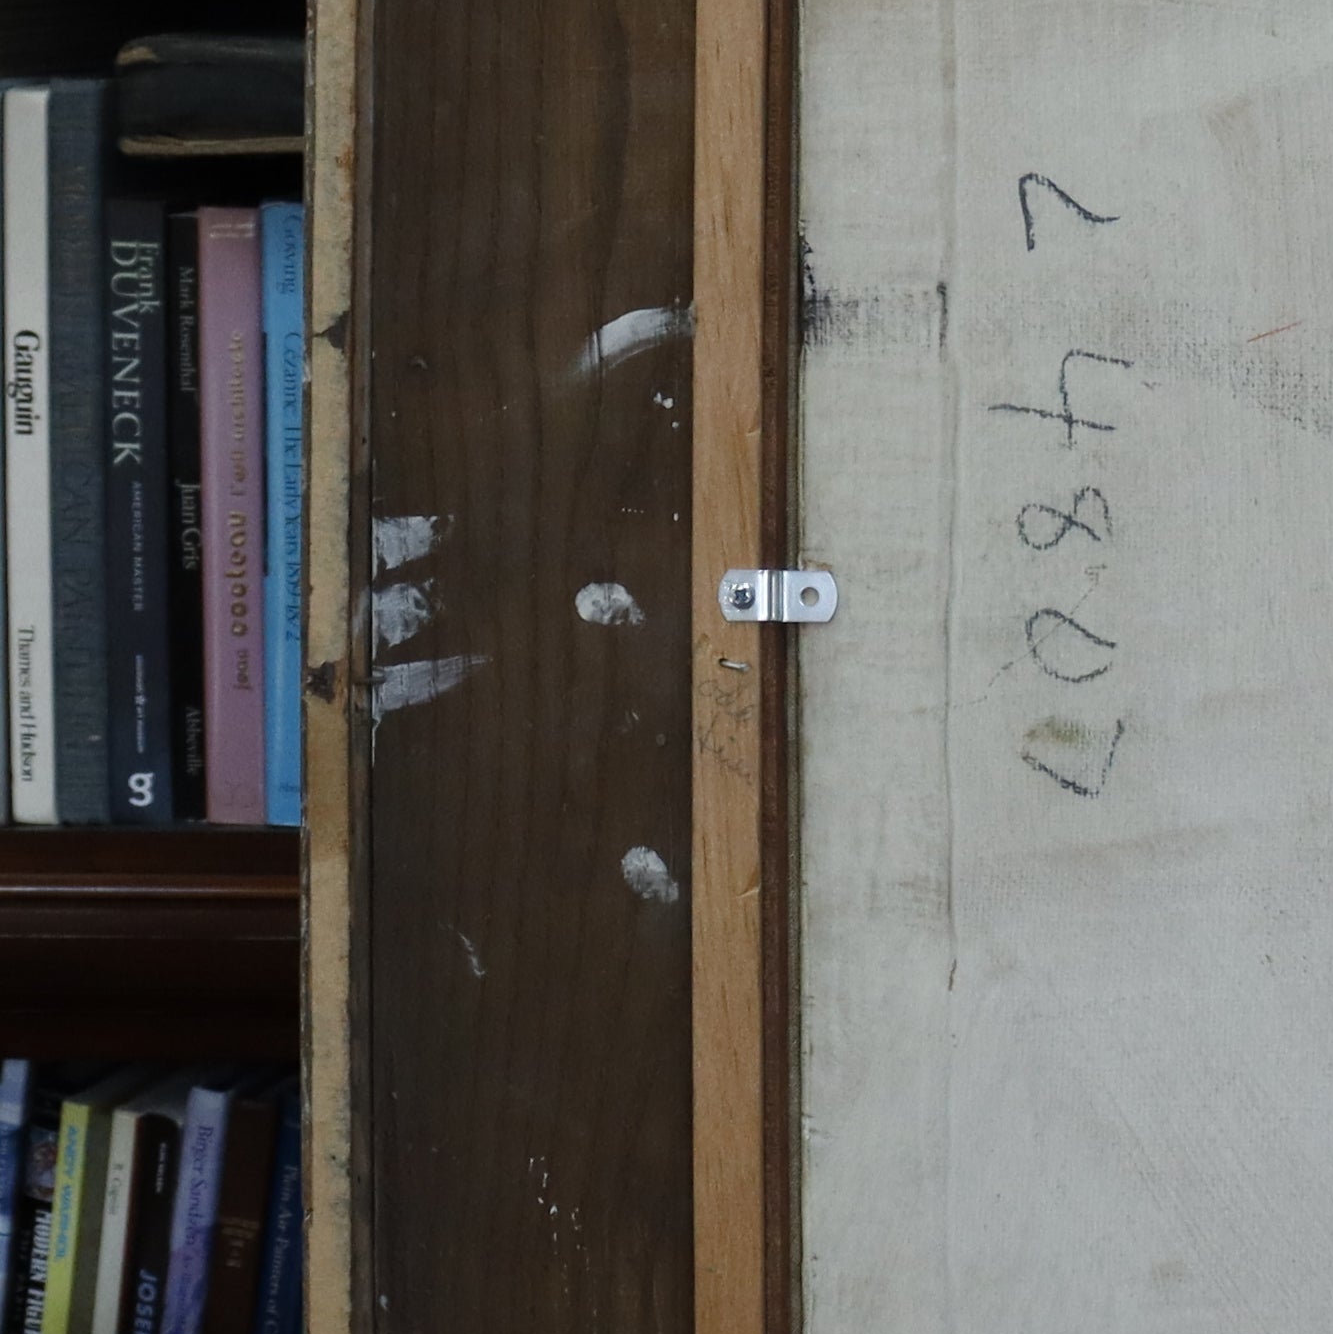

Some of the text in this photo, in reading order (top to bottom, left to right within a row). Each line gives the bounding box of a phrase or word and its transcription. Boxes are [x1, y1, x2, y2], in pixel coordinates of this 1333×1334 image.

[110, 239, 145, 612] DUVENECK AMERICAN MASTER
[137, 241, 161, 314] Frank
[9, 329, 41, 783] Gauguin Thames and Hudson
[176, 265, 203, 777] Mark Rosenthal Juan Gris Abbeville
